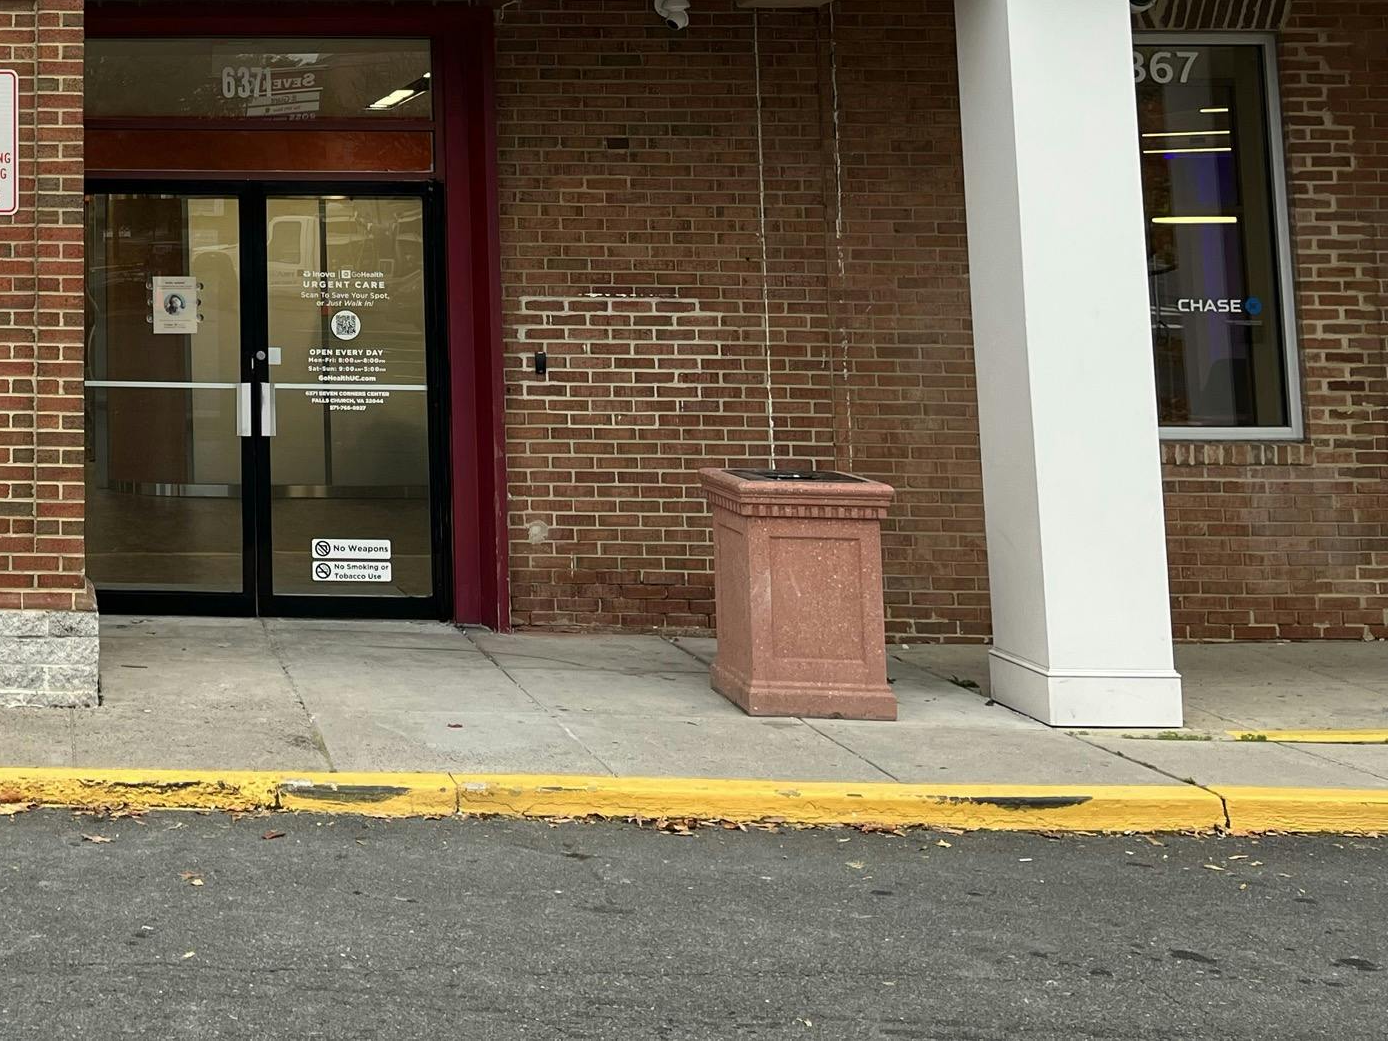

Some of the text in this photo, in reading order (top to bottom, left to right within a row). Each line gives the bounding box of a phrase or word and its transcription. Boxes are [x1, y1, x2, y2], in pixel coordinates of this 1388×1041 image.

[221, 66, 272, 99] 6371
[303, 280, 385, 289] URGENT CARE
[300, 291, 319, 299] Scan
[370, 292, 391, 301] Spot,
[1177, 299, 1242, 312] CHASE
[309, 348, 333, 356] OPEN
[318, 374, 377, 382] GoHealthUC.com
[333, 544, 389, 553] No Weapons
[346, 563, 379, 571] Smoking
